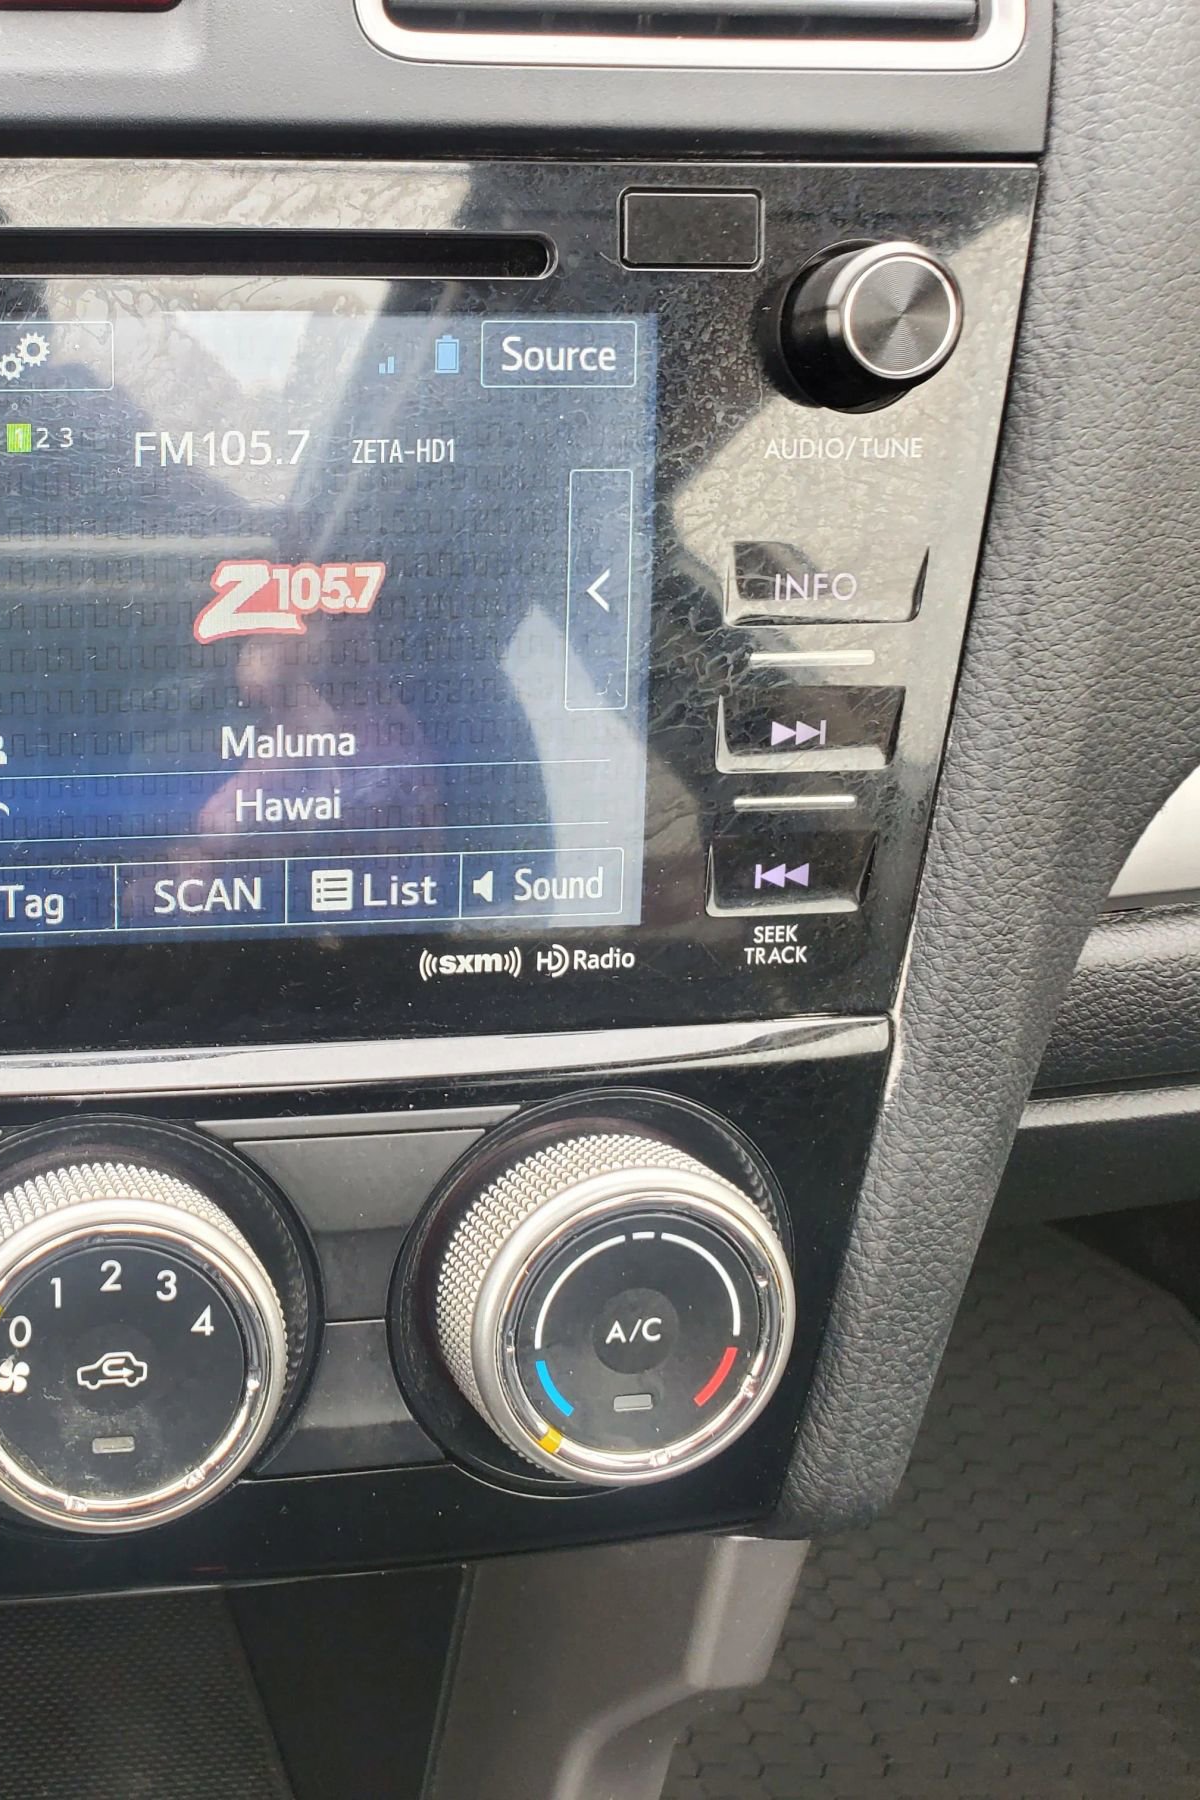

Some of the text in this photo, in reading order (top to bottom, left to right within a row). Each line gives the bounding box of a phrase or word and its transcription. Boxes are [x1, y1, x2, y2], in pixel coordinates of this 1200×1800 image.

[500, 336, 617, 373] Source
[36, 427, 50, 448] 2
[60, 427, 74, 448] 3
[351, 438, 456, 464] ZETA-HD1
[763, 437, 923, 461] AUDIO/TUNE
[774, 572, 858, 602] INFO
[220, 725, 357, 761] Maluma
[234, 789, 342, 824] Hawai
[0, 866, 604, 924] Tag SCAN List Sound
[753, 924, 799, 944] SEEK
[573, 946, 636, 971] Radio
[744, 945, 808, 965] TRACK
[8, 1260, 215, 1348] 0 1 2 3 4
[605, 1317, 663, 1345] A/C
